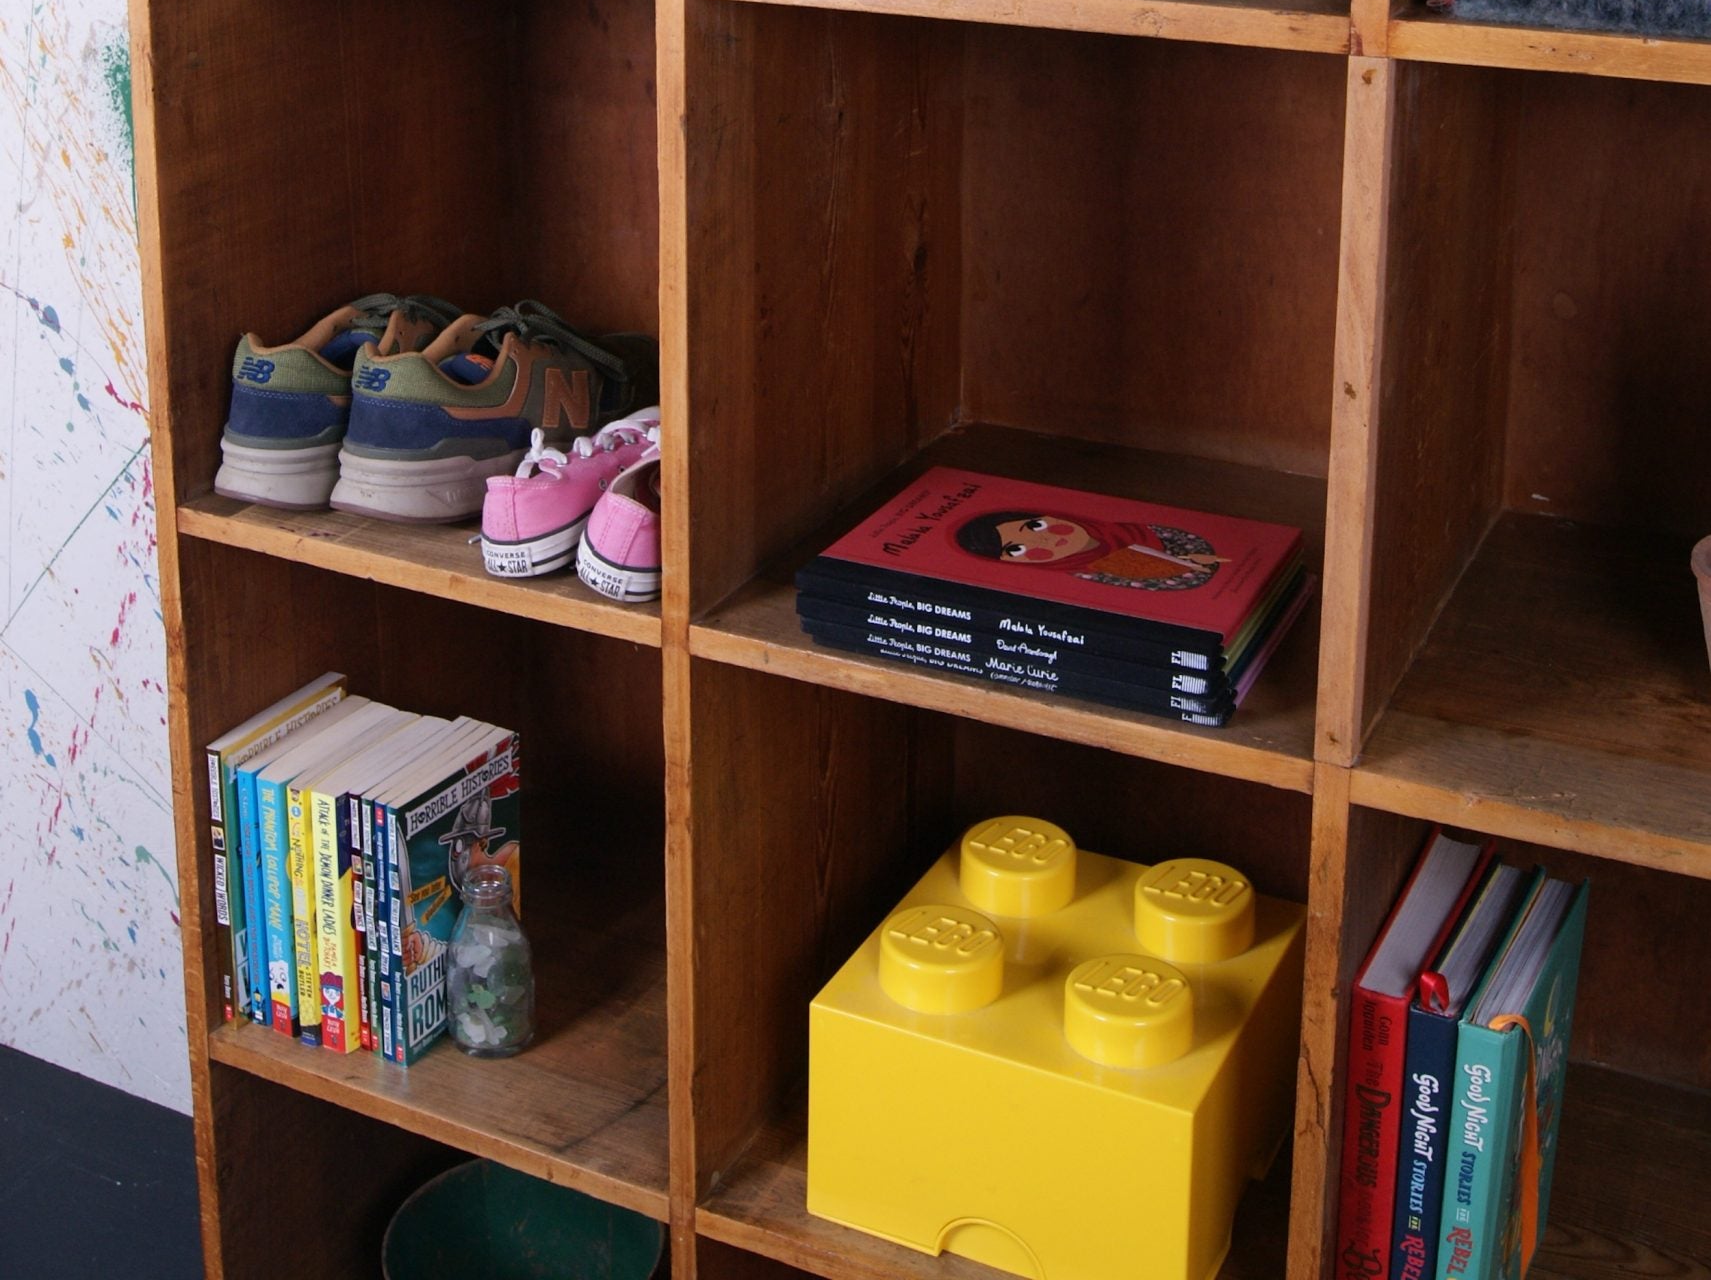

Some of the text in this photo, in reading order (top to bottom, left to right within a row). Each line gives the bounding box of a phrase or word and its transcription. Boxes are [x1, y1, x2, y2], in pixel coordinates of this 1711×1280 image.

[542, 367, 591, 430] N
[486, 549, 526, 559] CONVERSE
[882, 525, 933, 557] Malala
[487, 559, 528, 574] ALL STAR
[580, 567, 621, 598] ALL STAR
[583, 558, 624, 585] CONVERSE
[867, 591, 889, 605] Little
[916, 601, 933, 613] BIG
[934, 605, 972, 621] DREAMS
[999, 618, 1034, 636] Malala
[1038, 624, 1085, 646] Yousafzai
[867, 614, 889, 628] Little
[916, 624, 933, 636] BIG
[934, 627, 972, 644] DREAMS
[867, 633, 889, 647] Little
[916, 643, 933, 655] BIG
[934, 646, 971, 663] DREAMS
[985, 656, 1025, 675] Marie
[1026, 663, 1060, 683] Curie
[262, 789, 275, 804] THE
[317, 799, 331, 826] ATTACK
[409, 787, 458, 833] HORRIBLE
[461, 754, 510, 799] HISTORIES
[262, 806, 279, 851] PHANTOM
[968, 821, 1070, 864] LEGO
[320, 851, 333, 879] DEMON
[1142, 865, 1250, 908] LEGO
[216, 856, 229, 920] WICKED WORDS
[321, 879, 335, 908] DINNER
[295, 918, 312, 968] HOTEL
[322, 908, 337, 936] LADIES
[888, 910, 998, 955] LEGO
[410, 949, 449, 1001] RUTHL
[1074, 960, 1187, 1005] LEGO
[412, 979, 448, 1041] ROM
[1378, 1015, 1393, 1046] Conn
[1409, 1159, 1428, 1214] STORIES
[1456, 1150, 1477, 1207] STORIES
[1400, 1233, 1427, 1280] REBEL
[1445, 1225, 1474, 1275] REBEL
